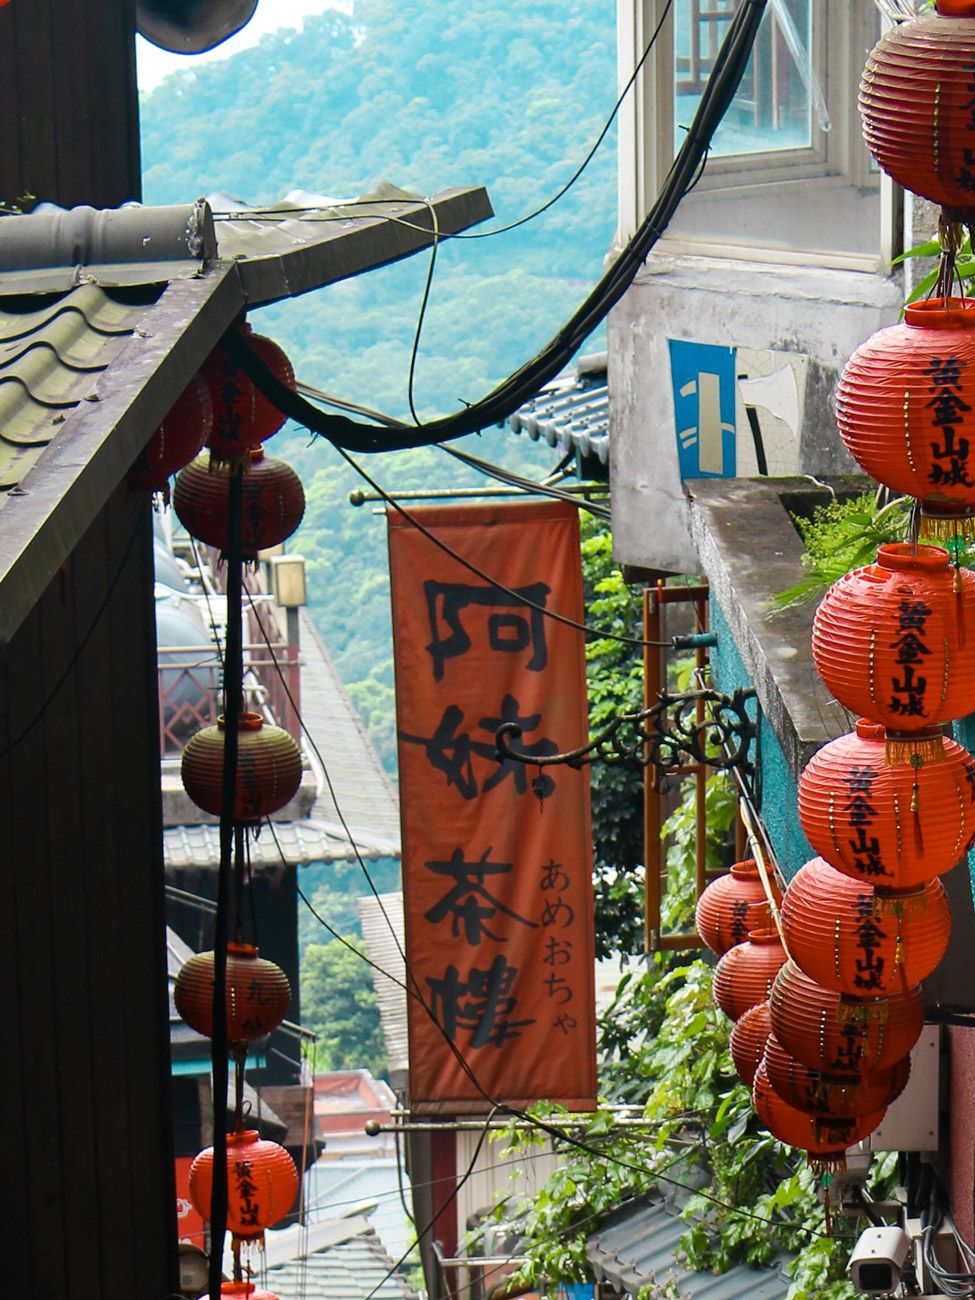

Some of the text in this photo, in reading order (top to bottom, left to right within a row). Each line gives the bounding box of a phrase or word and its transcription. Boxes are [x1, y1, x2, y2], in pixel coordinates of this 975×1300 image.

[923, 357, 975, 489] 黃金山城
[889, 601, 931, 718] 黃金山城
[399, 580, 559, 1050] 阿妹茶樓
[843, 766, 895, 877] 黃金山城
[539, 859, 577, 1037] あめおちゃ
